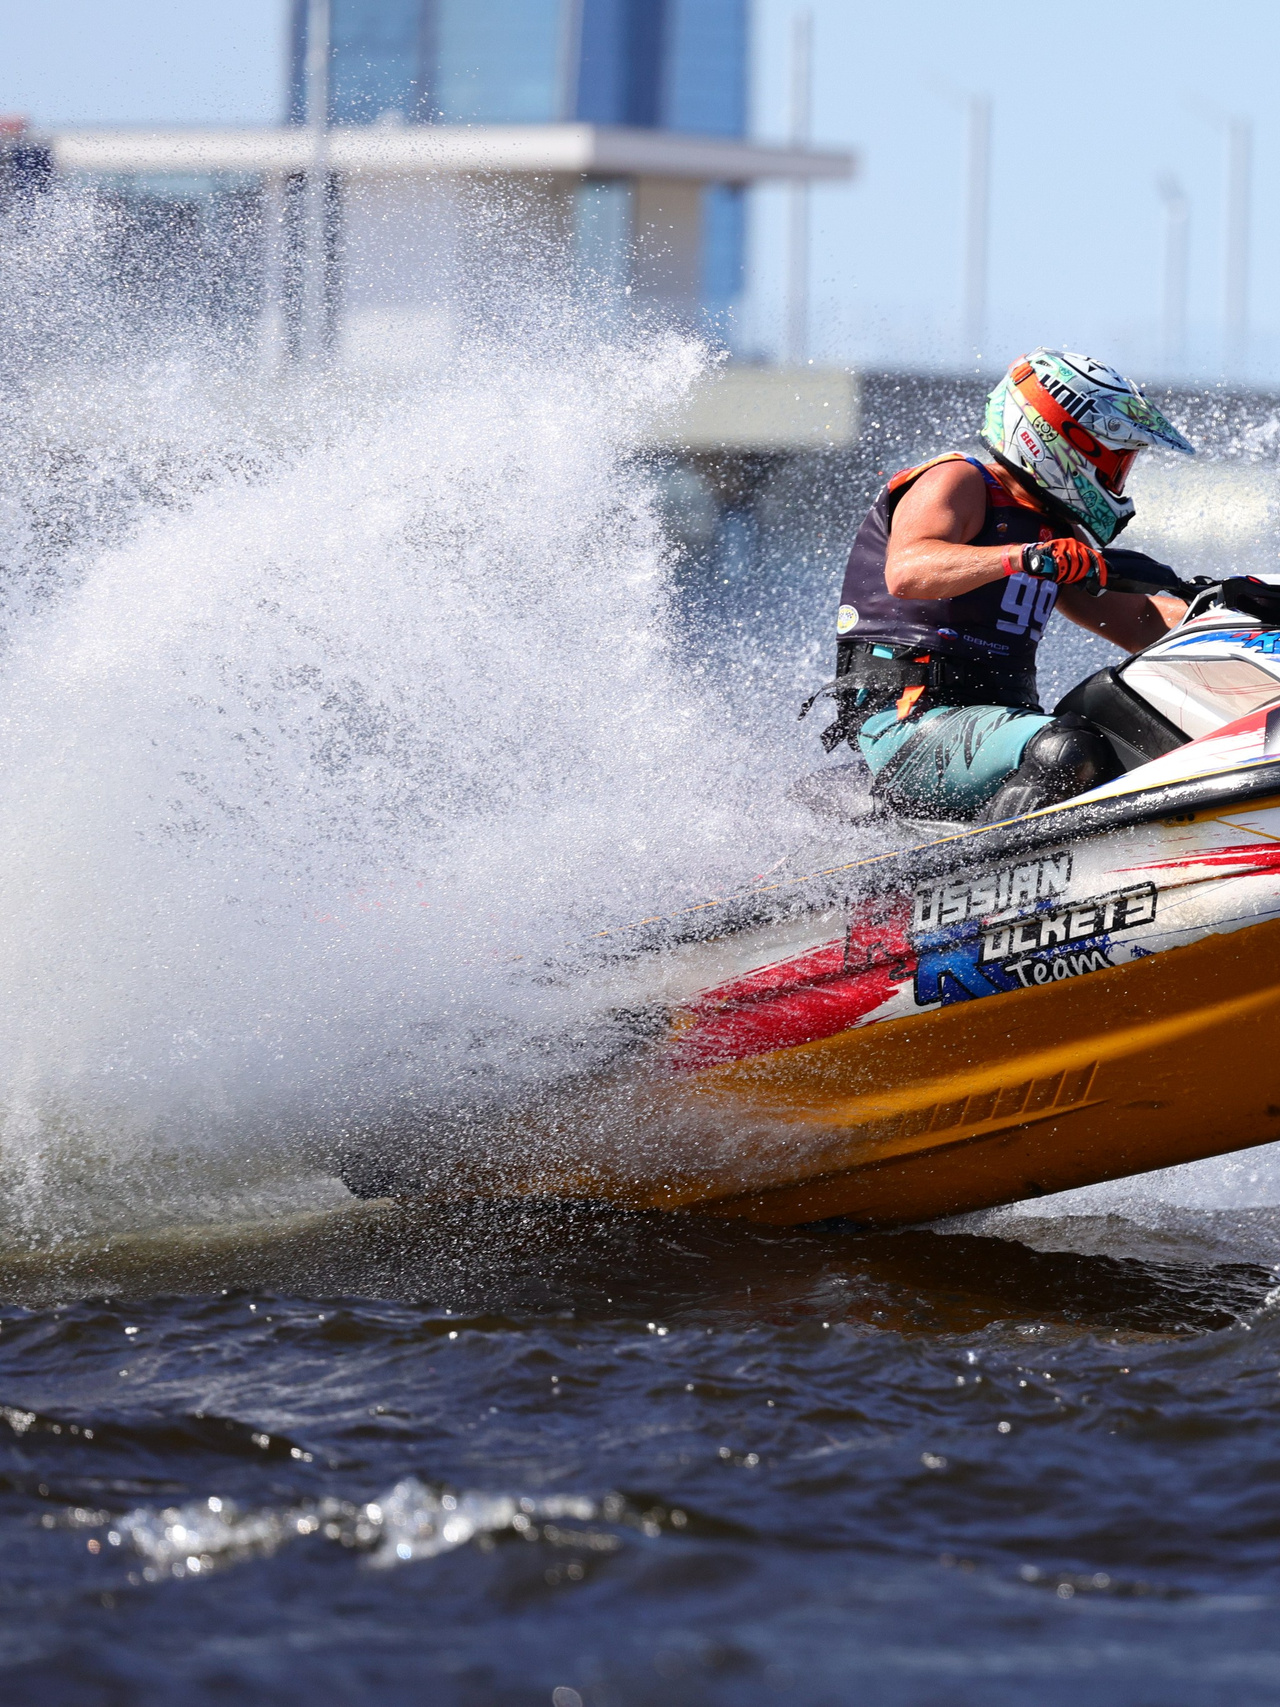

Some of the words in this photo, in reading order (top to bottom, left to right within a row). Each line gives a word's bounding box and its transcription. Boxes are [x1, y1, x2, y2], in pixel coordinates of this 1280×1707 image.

[1020, 431, 1041, 459] BELL
[995, 571, 1059, 643] 99
[1004, 948, 1113, 988] Team
